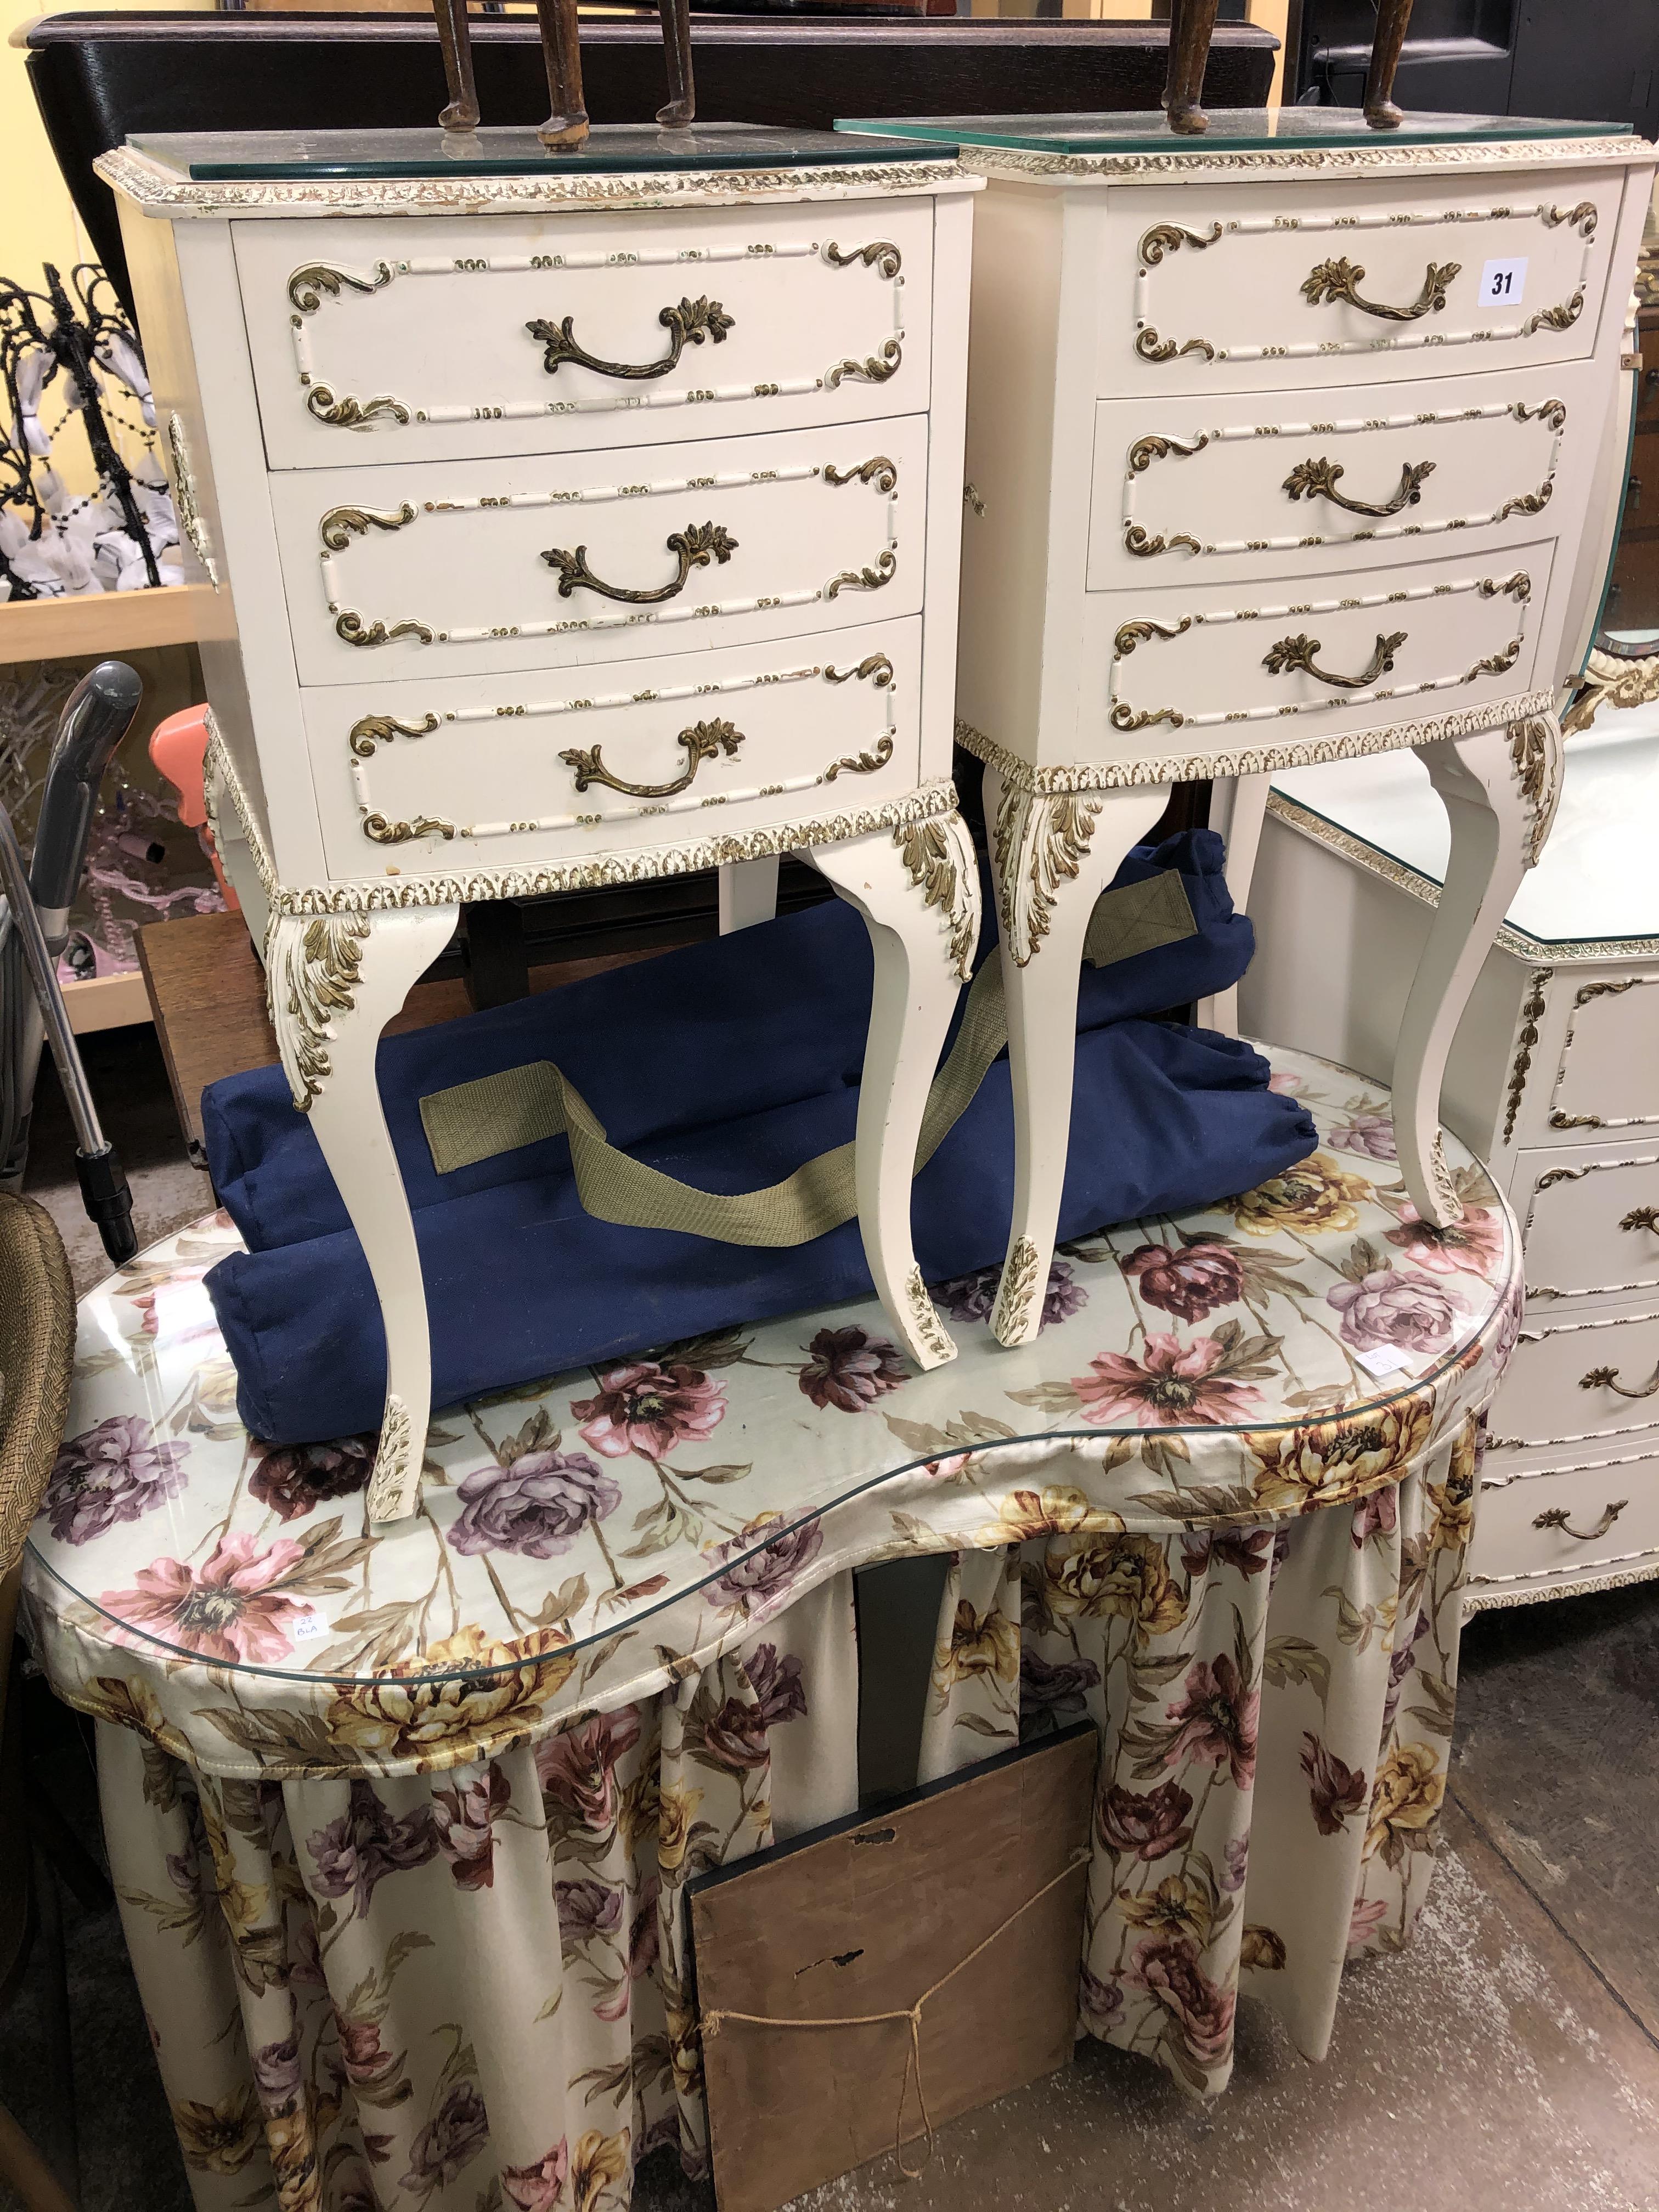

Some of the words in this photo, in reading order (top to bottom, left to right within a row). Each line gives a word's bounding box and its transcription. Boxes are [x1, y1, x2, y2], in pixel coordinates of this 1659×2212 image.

[1491, 272, 1513, 295] 31
[1376, 1359, 1397, 1370] 31
[300, 1616, 312, 1624] 22
[297, 1626, 318, 1636] BLA
